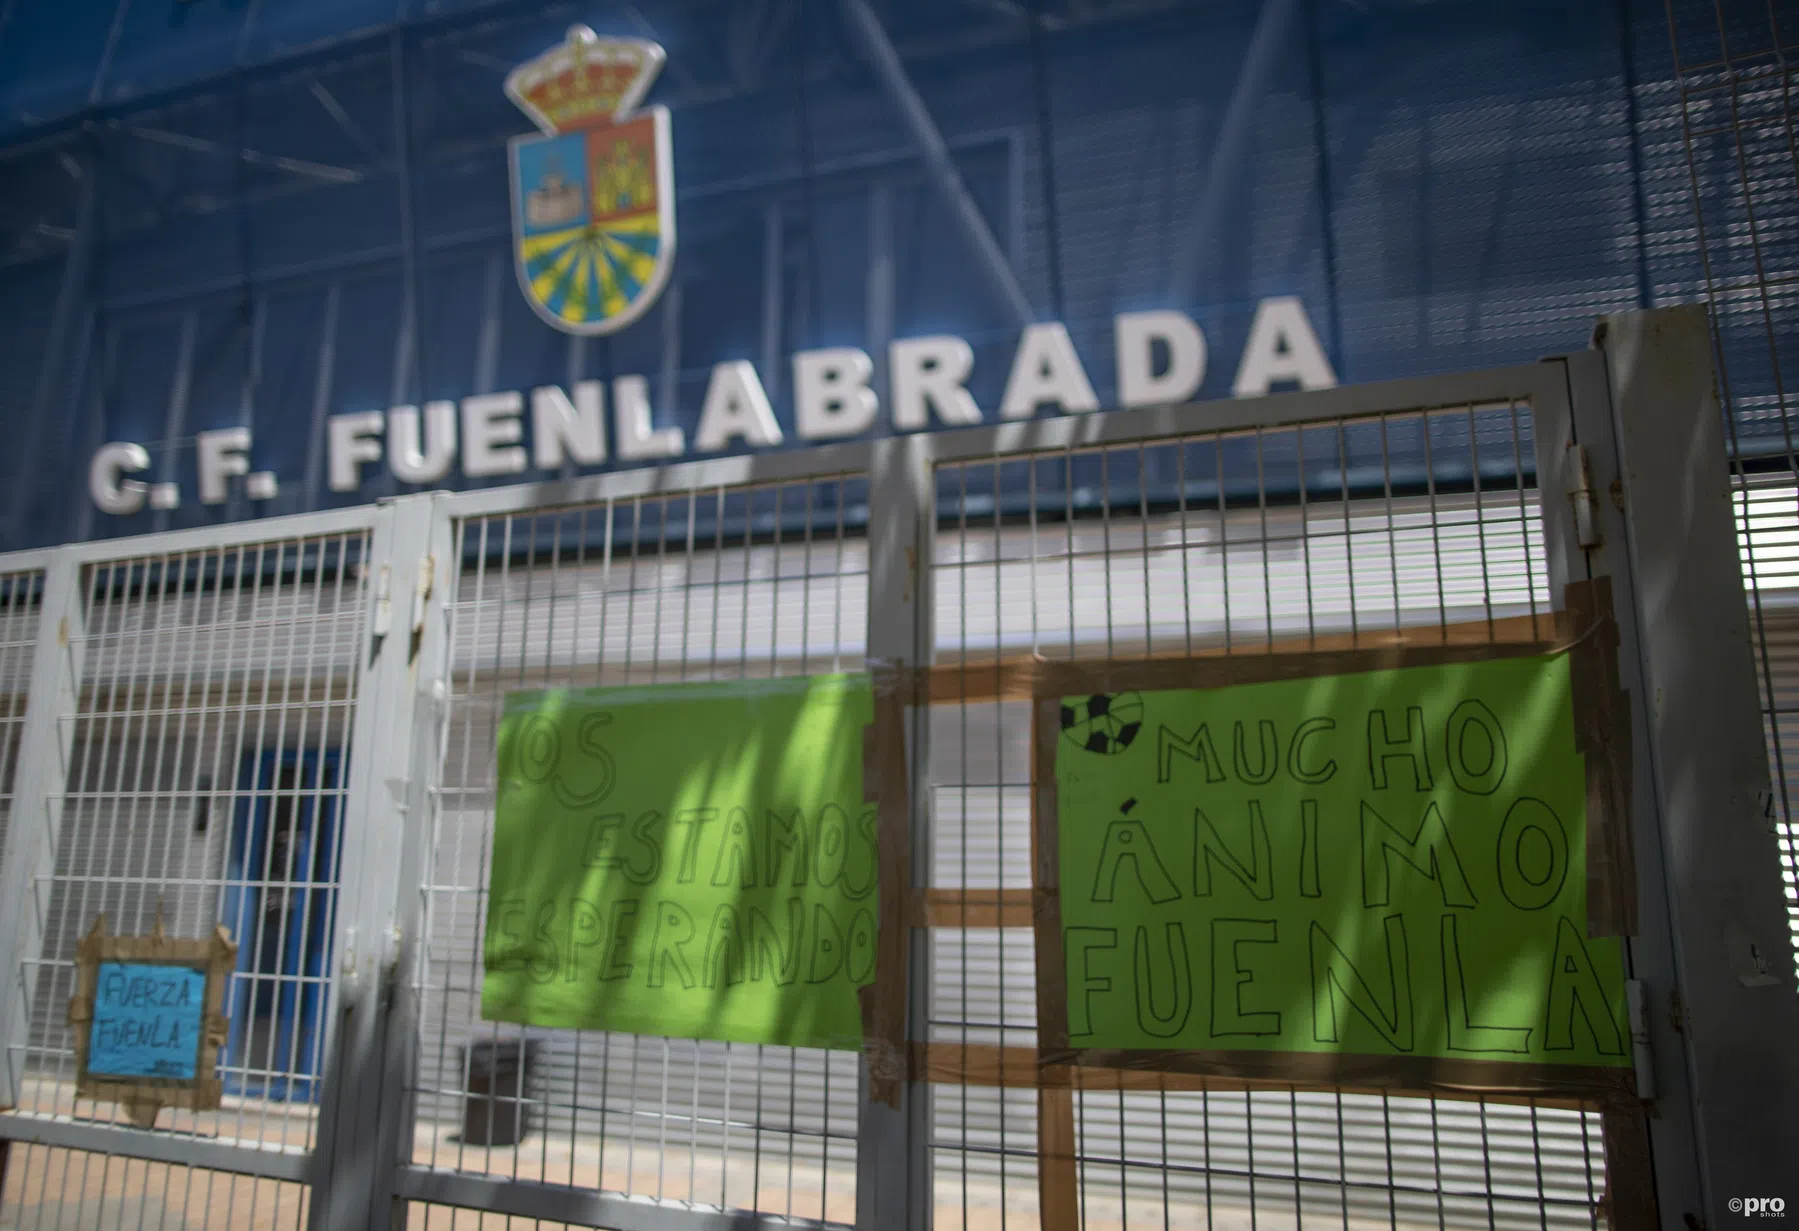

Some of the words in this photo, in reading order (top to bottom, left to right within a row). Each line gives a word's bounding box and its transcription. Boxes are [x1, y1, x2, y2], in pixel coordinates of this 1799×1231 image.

[328, 296, 1338, 491] FUENLABRADA
[518, 712, 616, 810] OS
[1157, 698, 1508, 796] MUCHO
[581, 803, 880, 900] ESTAMOS
[1091, 797, 1569, 910] ÁNIMO
[105, 971, 191, 1010] FUERZA
[484, 897, 877, 990] ESPERANDO
[1064, 913, 1626, 1056] FUENLA
[97, 1014, 181, 1051] FUENLA
